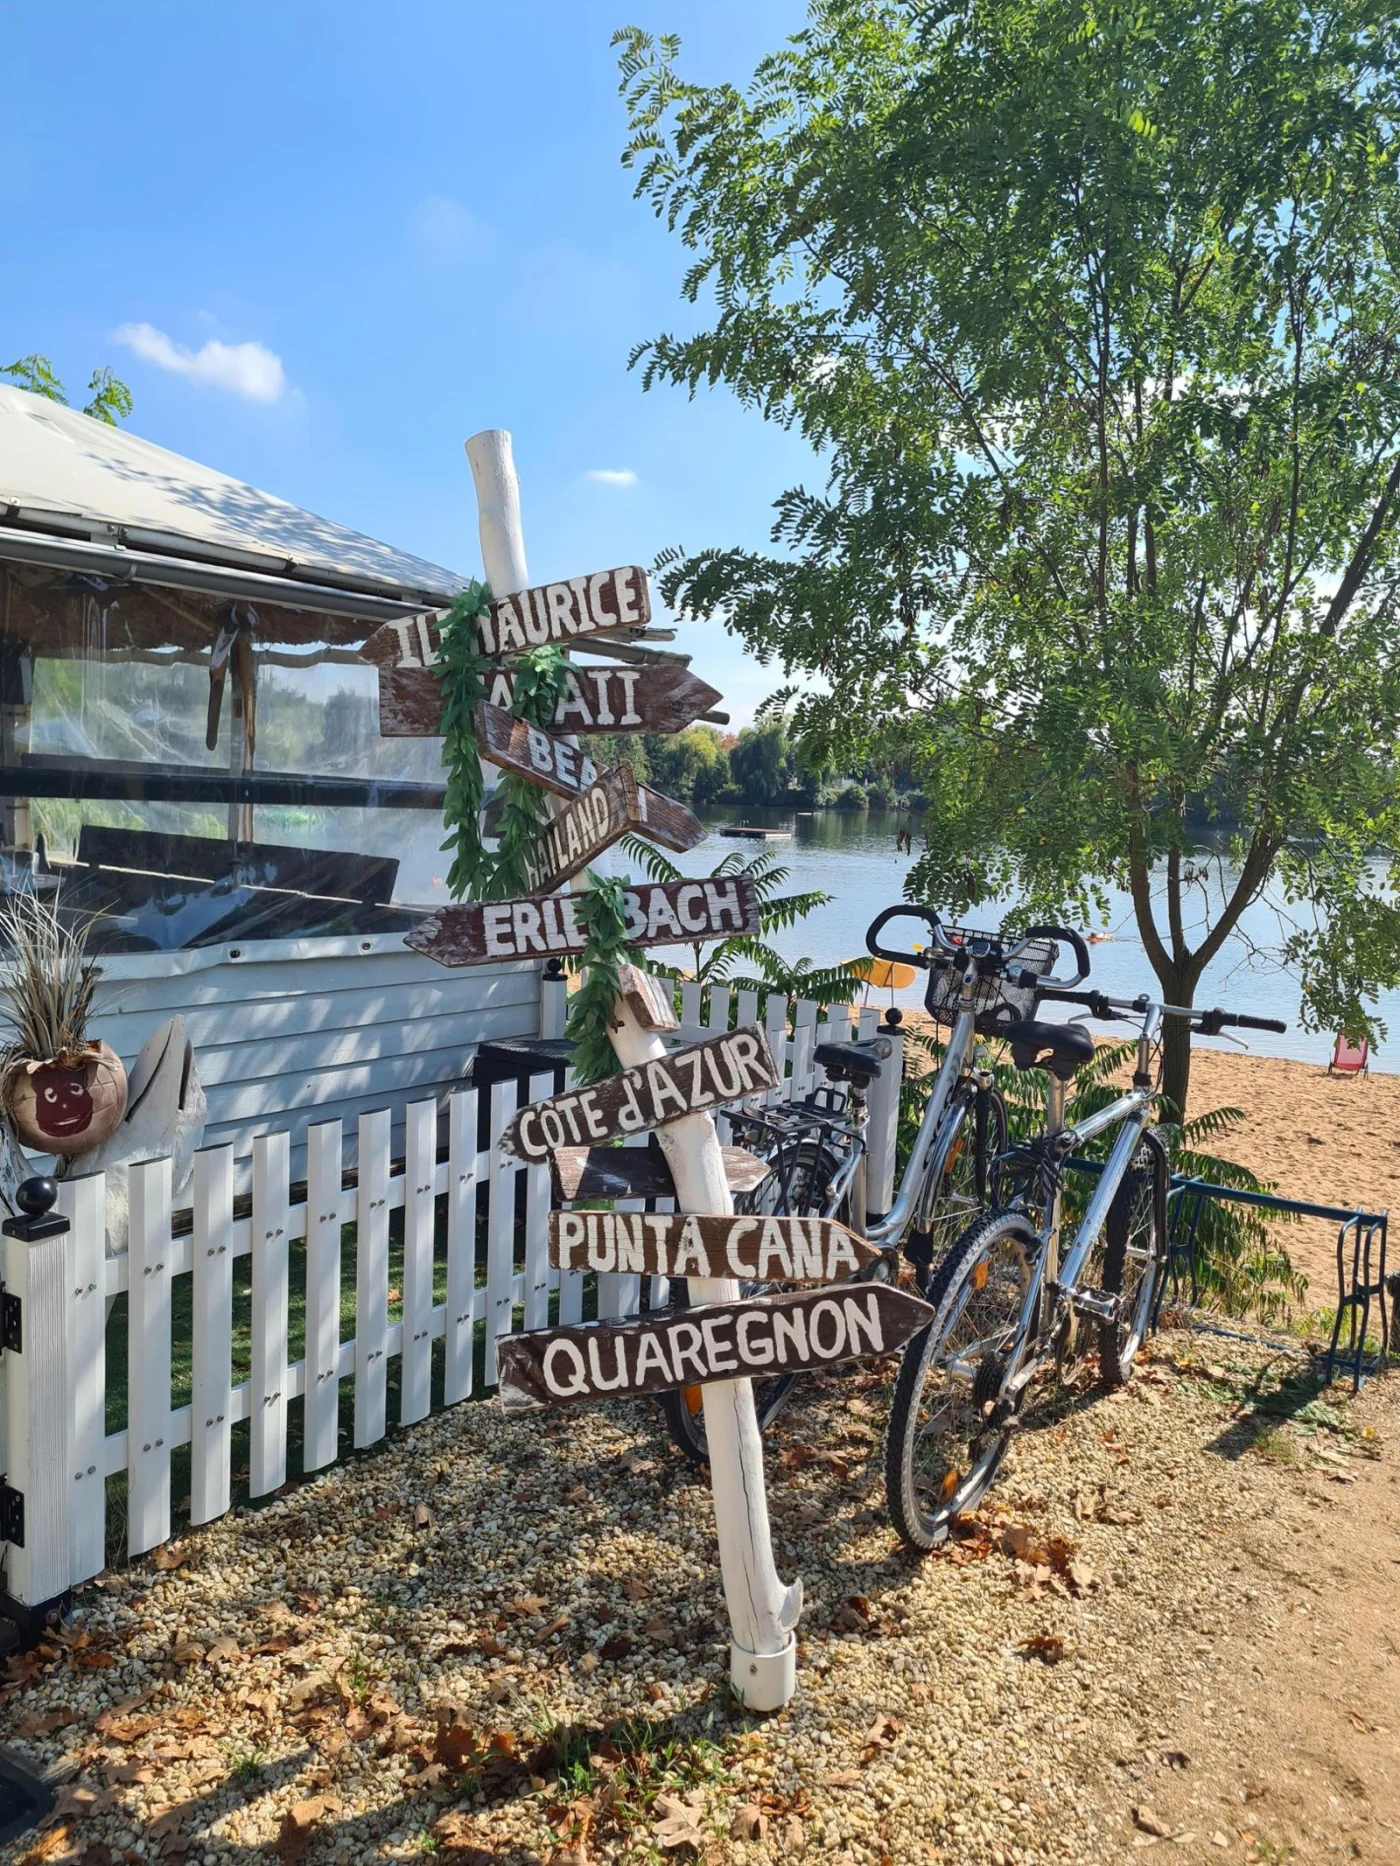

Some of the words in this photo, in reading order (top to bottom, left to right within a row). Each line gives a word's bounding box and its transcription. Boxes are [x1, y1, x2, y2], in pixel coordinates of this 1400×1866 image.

[475, 670, 642, 726] AAII
[524, 787, 609, 893] HAILAND
[482, 882, 745, 956] ERLEBACH
[519, 1088, 609, 1157] CÔTE
[558, 1212, 712, 1278] PUNTA
[725, 1218, 860, 1280] CANA
[542, 1292, 885, 1397] QUAREGNON
